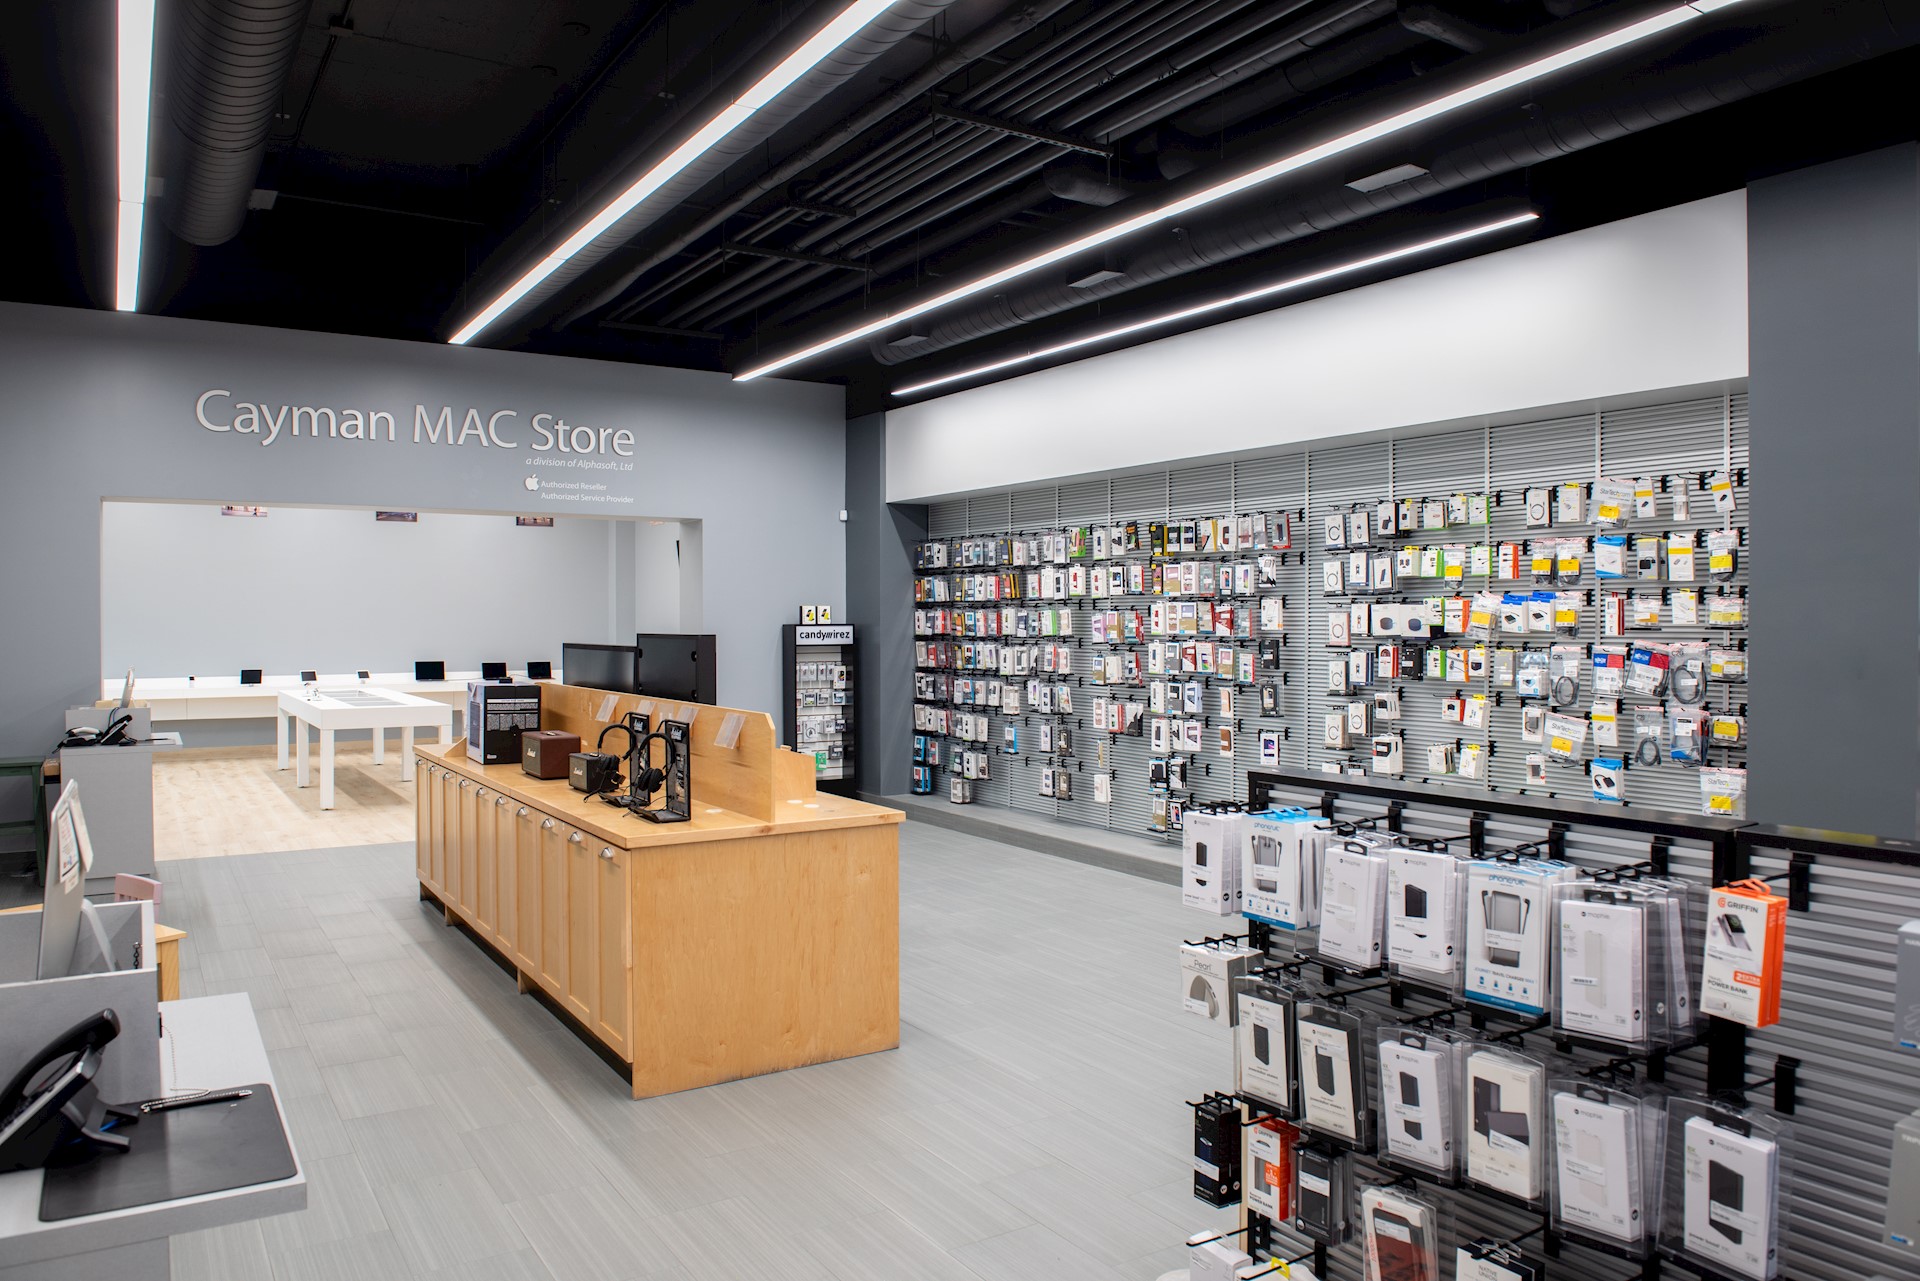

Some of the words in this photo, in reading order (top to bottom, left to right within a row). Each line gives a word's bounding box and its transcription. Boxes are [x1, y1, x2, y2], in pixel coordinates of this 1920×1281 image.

[195, 389, 396, 447] Cayman
[413, 404, 519, 448] MAC
[530, 413, 636, 457] Store
[525, 457, 532, 465] a
[533, 456, 566, 468] division
[567, 458, 577, 468] of
[577, 459, 619, 471] Alphasoft,
[620, 462, 634, 471] Ltd
[541, 481, 579, 490] Authorized
[580, 482, 607, 491] Reseller
[541, 492, 580, 501] Authorized
[581, 493, 605, 503] Service
[606, 495, 634, 504] Provider
[799, 629, 850, 641] candywirez
[1727, 901, 1759, 914] GRIFFIN
[1194, 959, 1212, 970] Pearl
[1707, 979, 1730, 990] POWER
[1730, 985, 1748, 995] BANK
